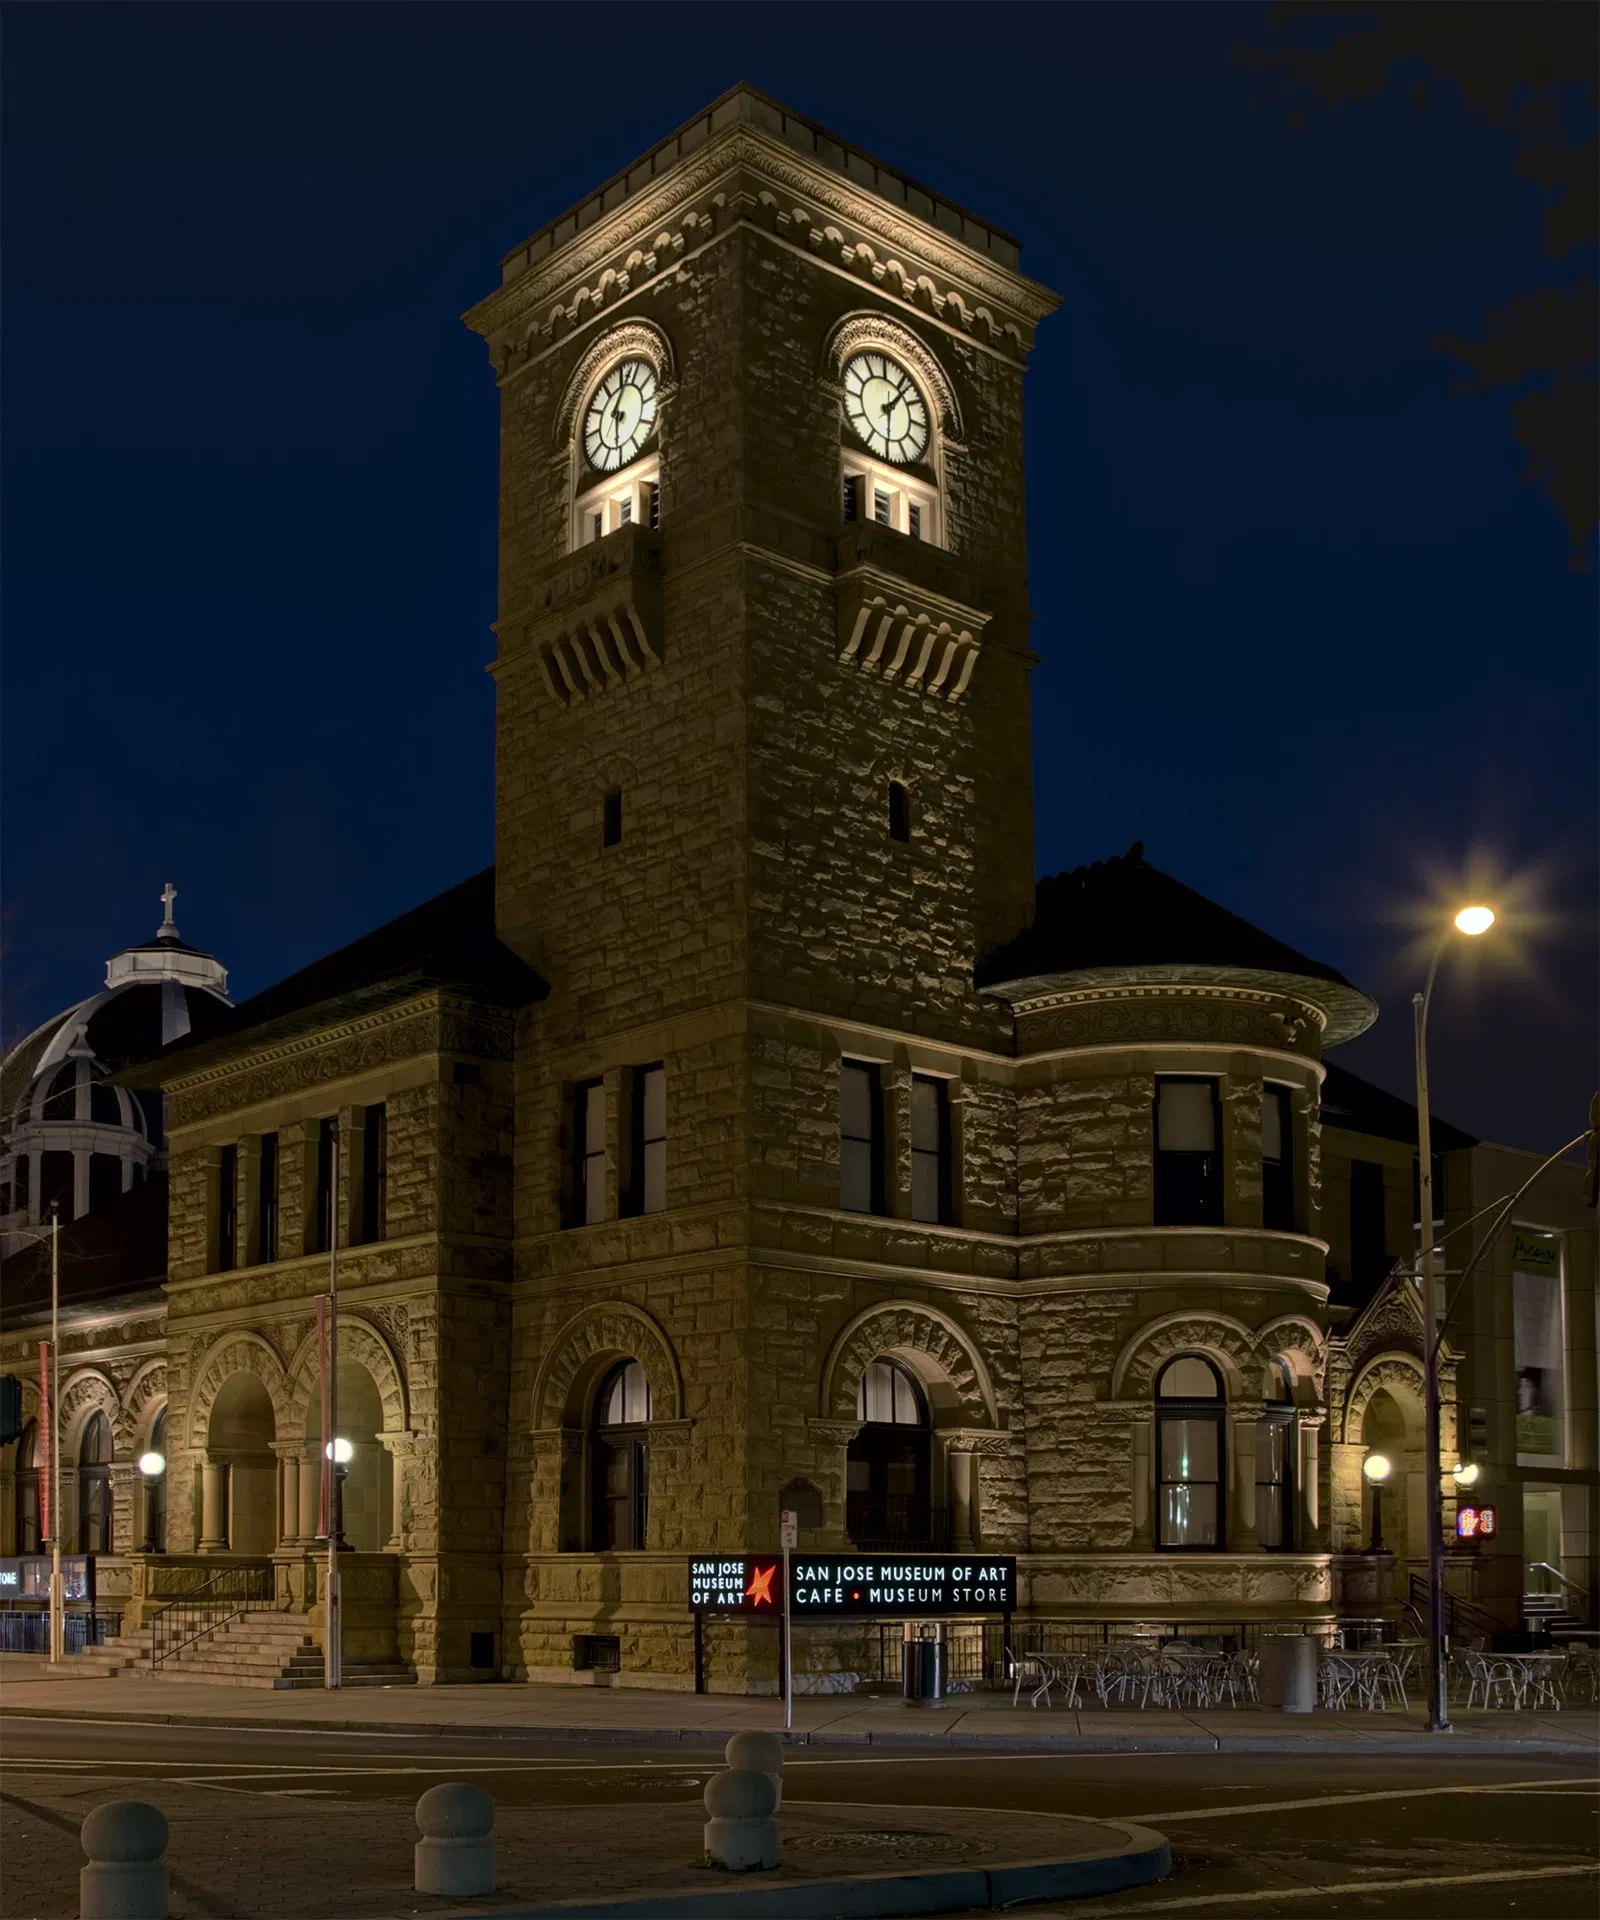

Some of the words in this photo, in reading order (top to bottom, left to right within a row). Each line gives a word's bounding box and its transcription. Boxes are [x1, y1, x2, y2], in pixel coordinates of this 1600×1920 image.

[692, 1562, 715, 1575] SAN
[717, 1562, 745, 1576] JOSE
[796, 1566, 829, 1581] SAN
[835, 1565, 874, 1585] JOSE
[880, 1566, 945, 1582] MUSEUM
[951, 1566, 972, 1582] OF
[978, 1567, 1008, 1581] ART
[692, 1576, 744, 1590] MUSEUM
[692, 1591, 710, 1605] OF
[716, 1592, 745, 1605] ART
[795, 1588, 843, 1604] CAFE
[869, 1588, 943, 1603] MUSEUM
[952, 1588, 1007, 1602] STORE
